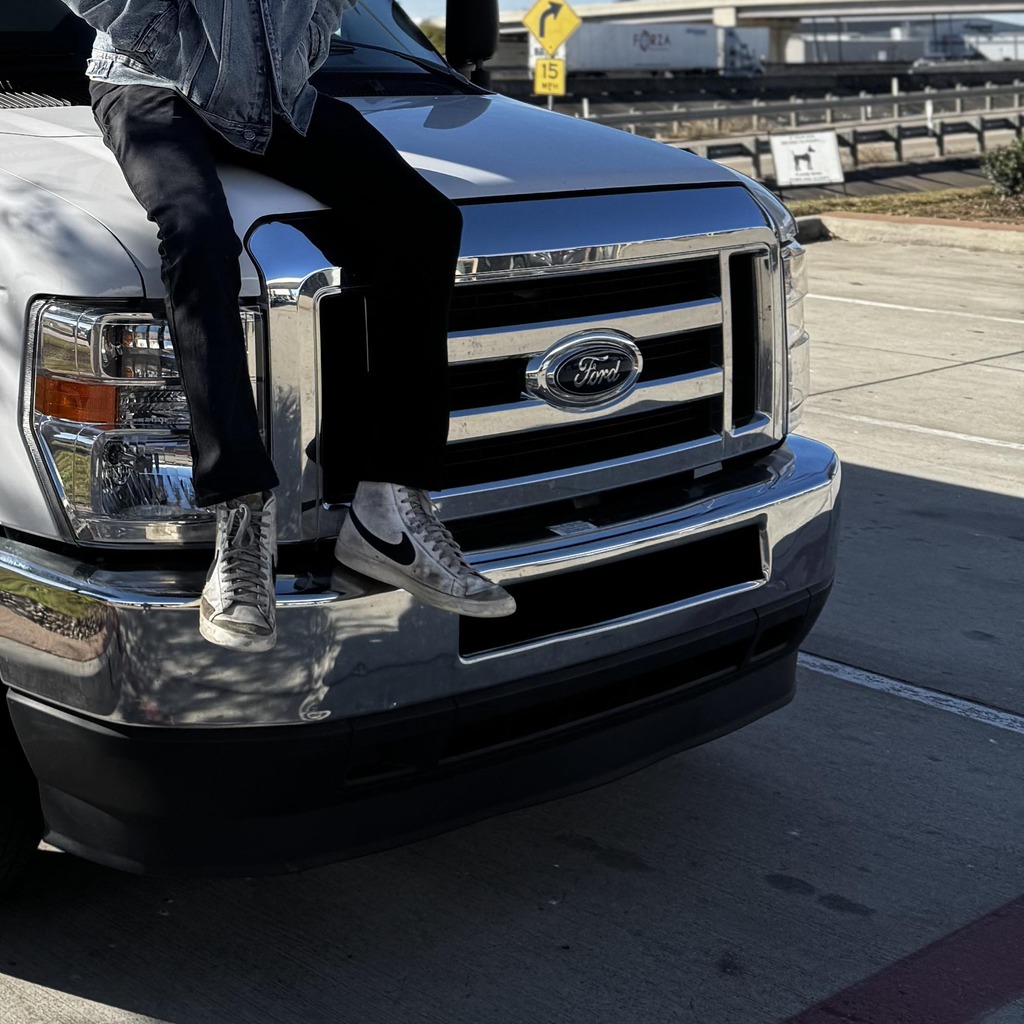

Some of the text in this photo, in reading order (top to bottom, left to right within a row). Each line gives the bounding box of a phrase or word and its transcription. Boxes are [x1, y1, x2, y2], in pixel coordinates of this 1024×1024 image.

[541, 64, 558, 79] 15
[542, 83, 558, 91] MPH
[574, 355, 620, 388] Ford
